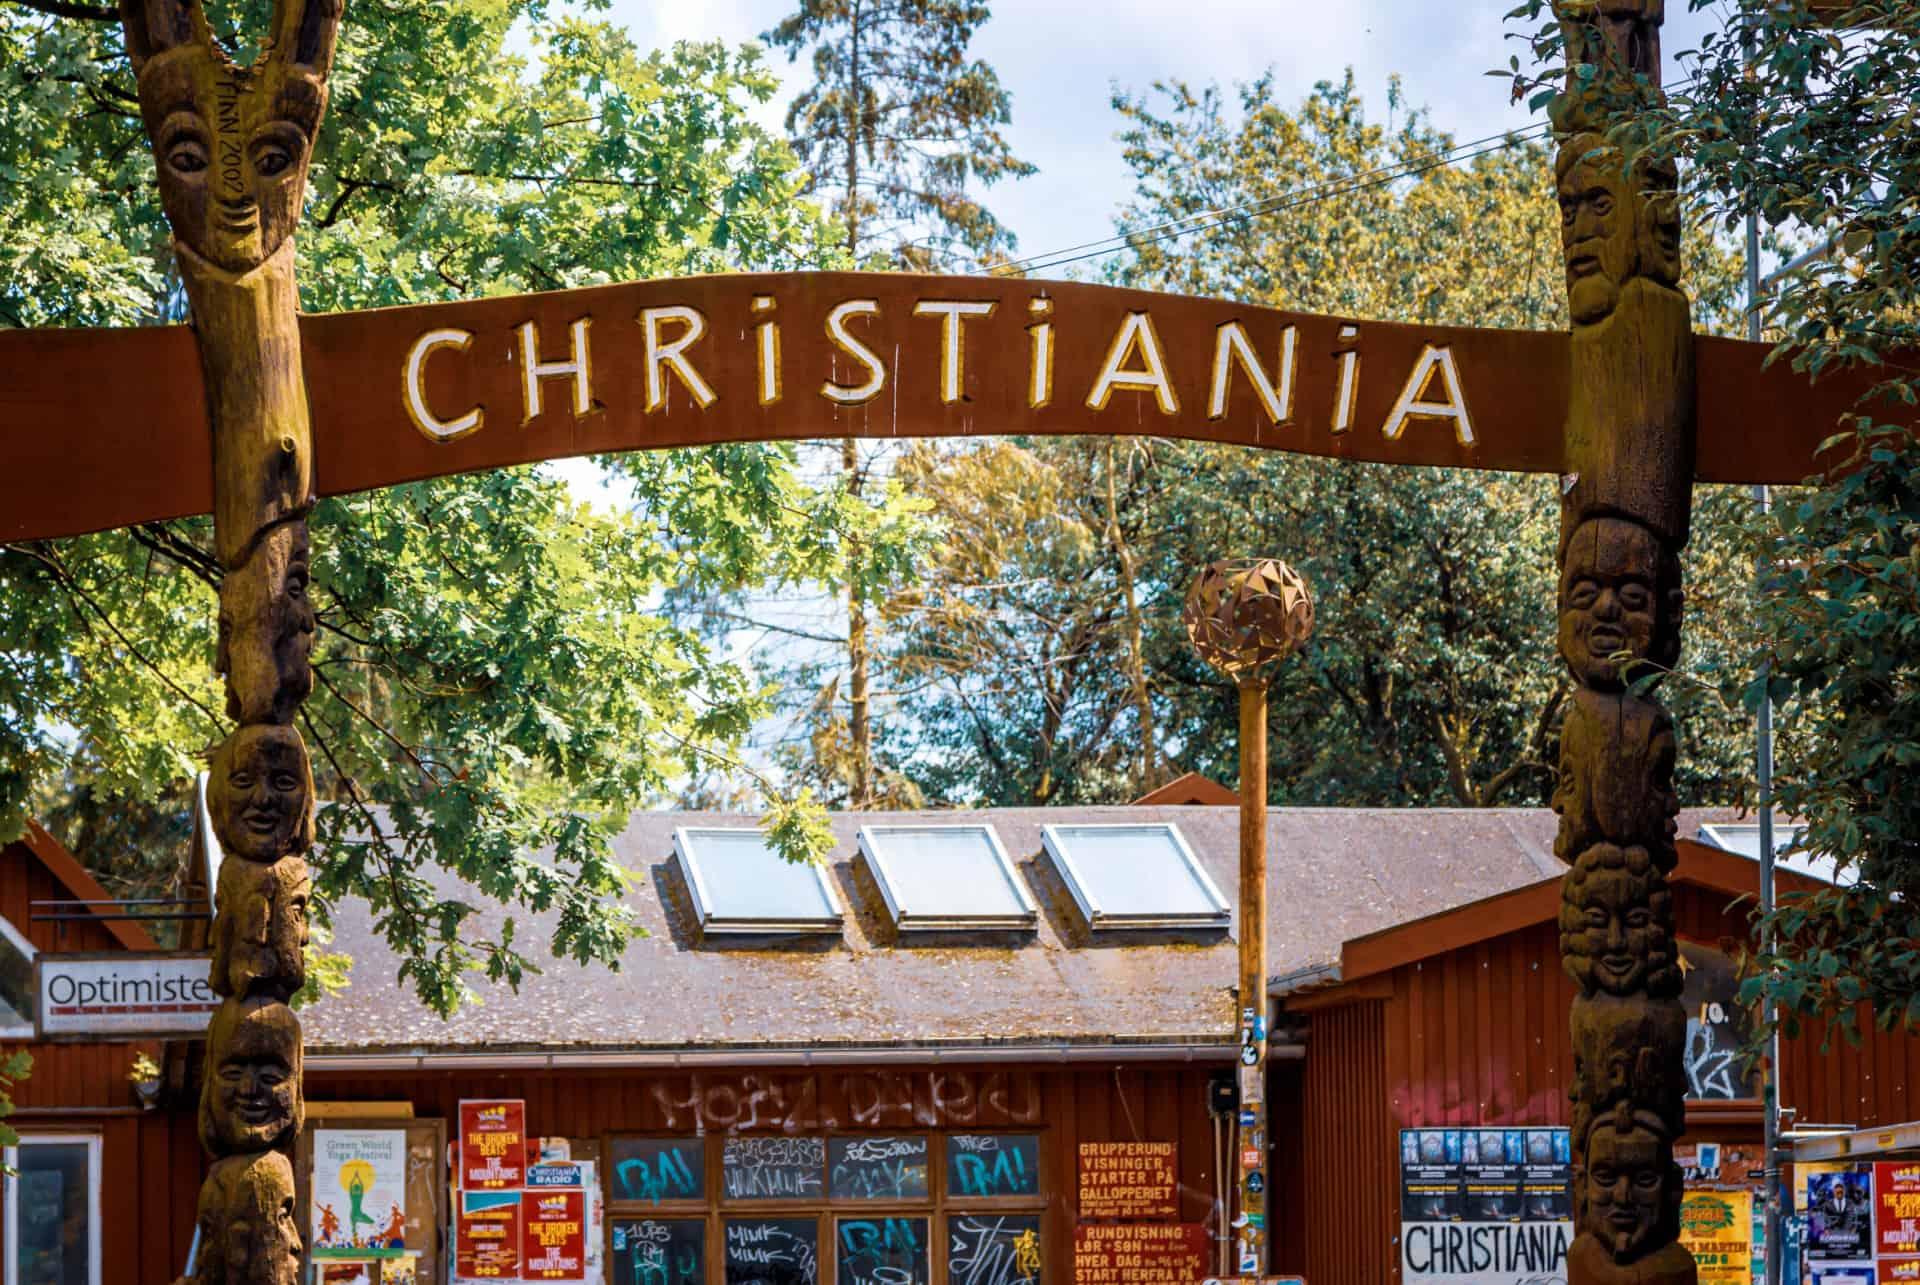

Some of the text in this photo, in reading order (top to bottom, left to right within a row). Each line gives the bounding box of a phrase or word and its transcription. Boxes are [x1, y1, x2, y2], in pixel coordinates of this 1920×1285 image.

[220, 140, 244, 193] 2002
[1084, 1158, 1163, 1169] VISNINGER
[535, 1176, 573, 1184] RADIO
[1080, 1166, 1174, 1184] STARTER PÅ
[1080, 1187, 1172, 1200] GALLOPPERIET
[1086, 1227, 1183, 1239] RUNDVISNING
[1075, 1240, 1102, 1252] LØR
[1114, 1240, 1142, 1252] SØN
[1405, 1226, 1567, 1273] CHRISTIANIA
[1075, 1255, 1109, 1267] HVER
[1116, 1255, 1142, 1267] DAG
[1075, 1263, 1195, 1281] START HERFRA PÅ
